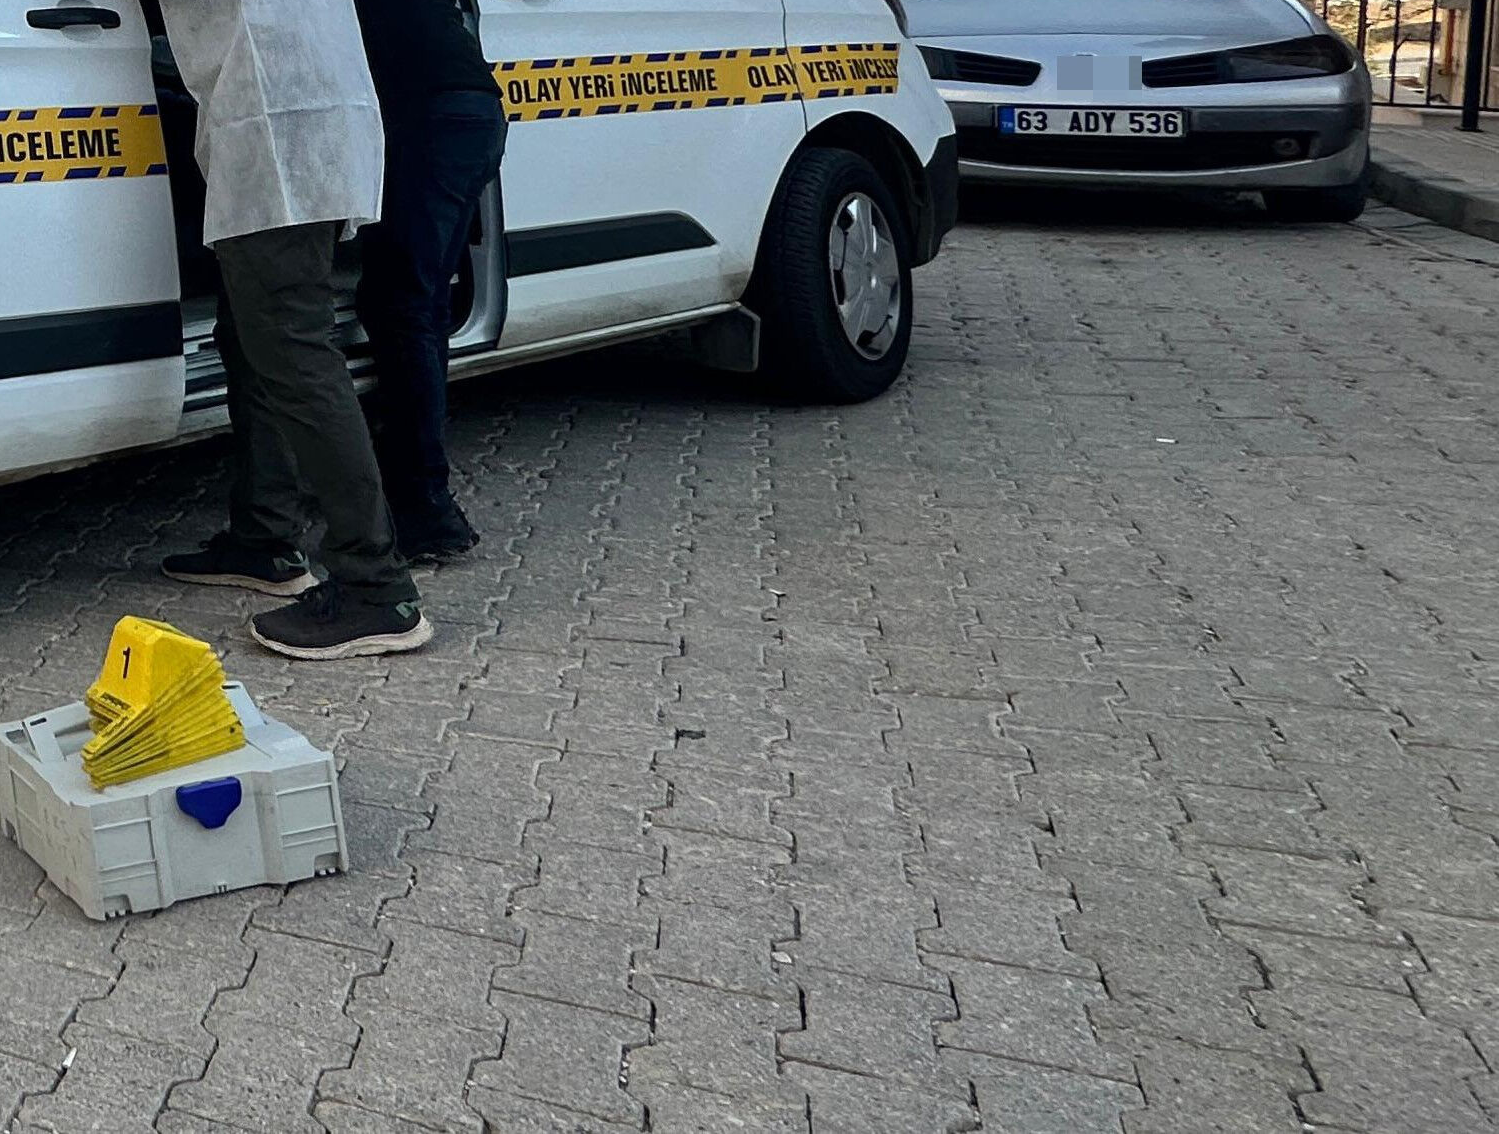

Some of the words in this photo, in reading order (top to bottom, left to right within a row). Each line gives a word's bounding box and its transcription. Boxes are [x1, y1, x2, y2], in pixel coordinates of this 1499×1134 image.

[748, 63, 798, 88] OLAY
[508, 78, 561, 104] OLAY
[1017, 111, 1048, 131] 63
[1069, 111, 1116, 133] ADY
[1129, 112, 1179, 134] 536
[123, 647, 131, 679] 1
